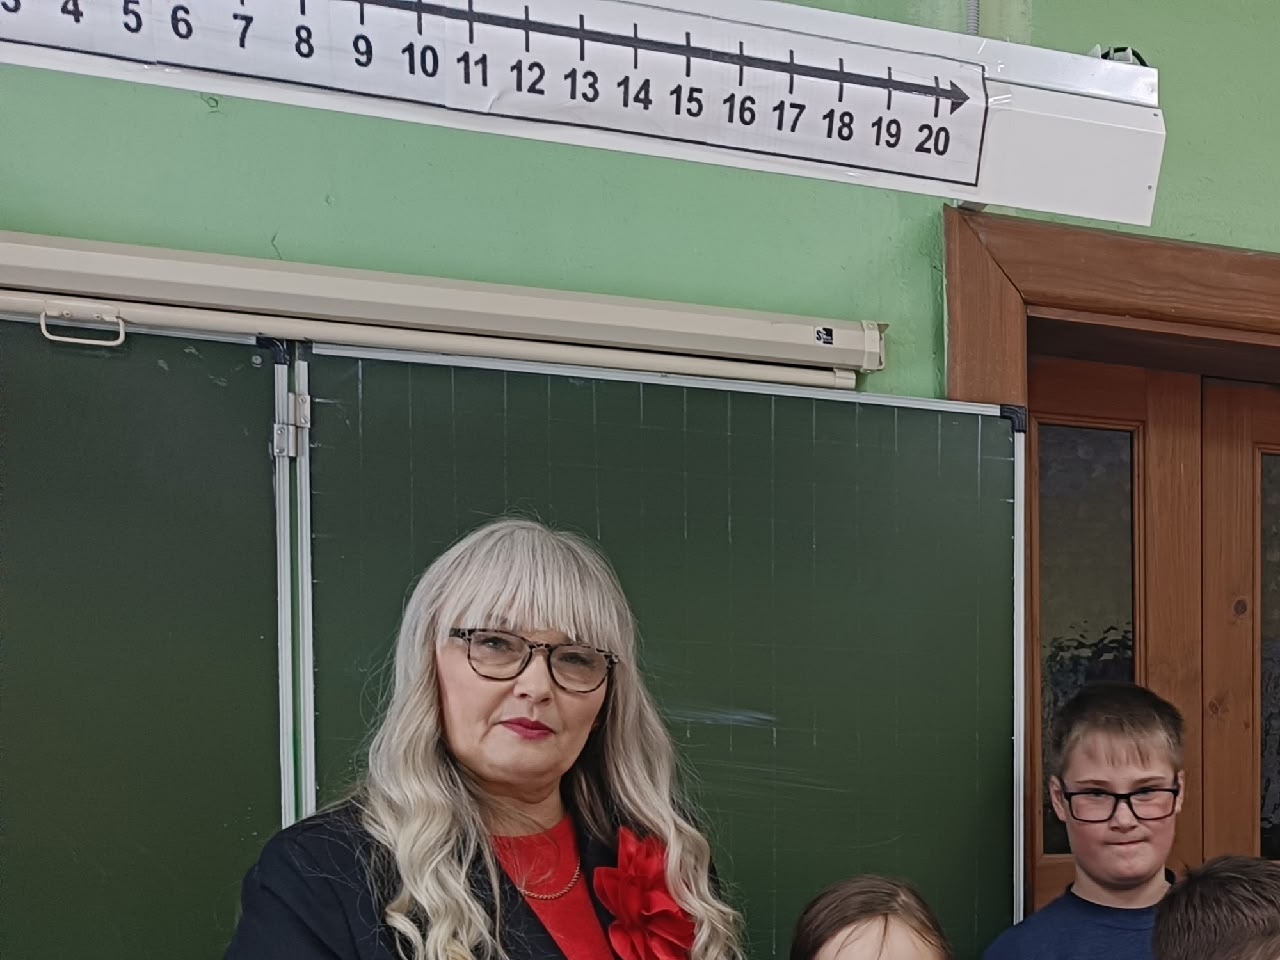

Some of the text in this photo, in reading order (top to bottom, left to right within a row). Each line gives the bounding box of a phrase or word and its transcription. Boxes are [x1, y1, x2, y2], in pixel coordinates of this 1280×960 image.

[61, 0, 950, 156] 4 5 6 7 8 9 10 11 12 13 14 15 16 17 18 19 20
